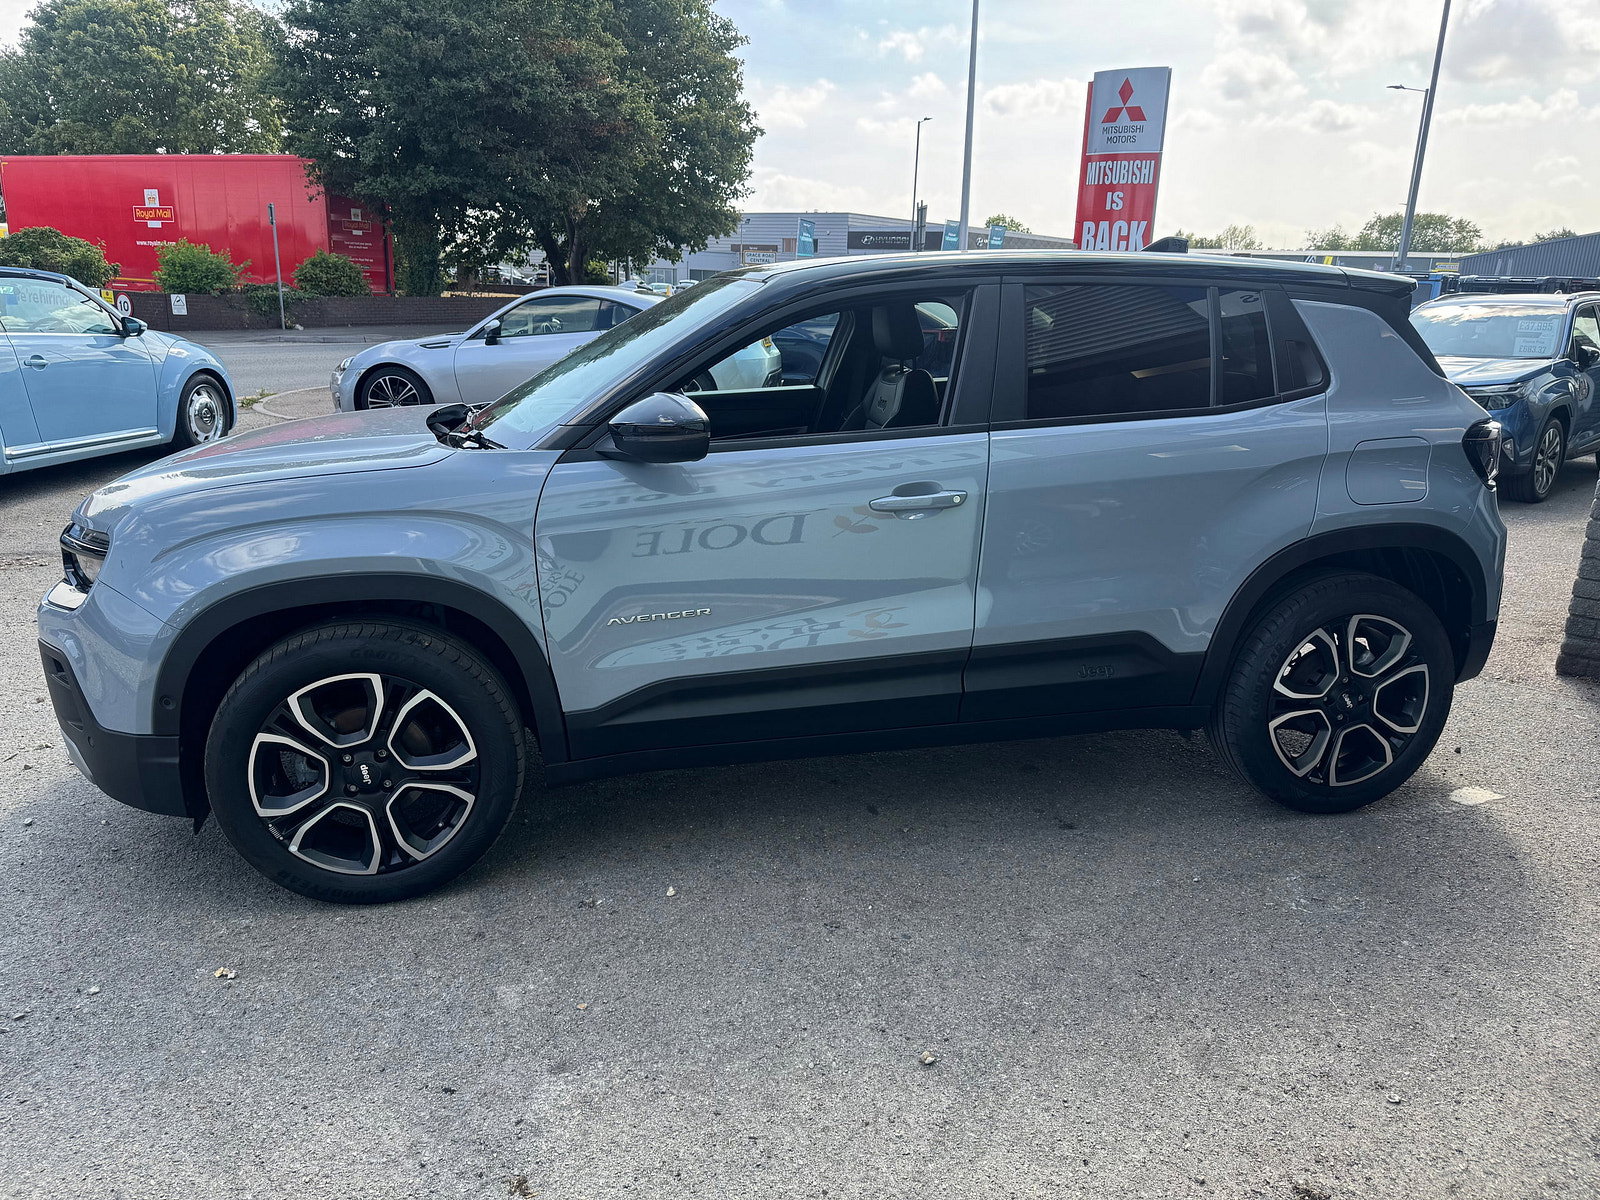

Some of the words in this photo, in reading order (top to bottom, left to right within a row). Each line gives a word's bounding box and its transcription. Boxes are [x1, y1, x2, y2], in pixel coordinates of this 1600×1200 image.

[1102, 125, 1144, 135] MITSUBISHI
[1106, 135, 1137, 145] MOTORS
[1086, 160, 1155, 185] MITSUBISHI
[1105, 191, 1124, 211] IS
[136, 209, 155, 219] Royal
[156, 209, 171, 219] Mail
[1081, 221, 1148, 251] BACK
[119, 301, 130, 312] 10
[606, 607, 712, 627] AVENGER
[1076, 664, 1115, 679] Jeep
[359, 763, 372, 785] Jeep
